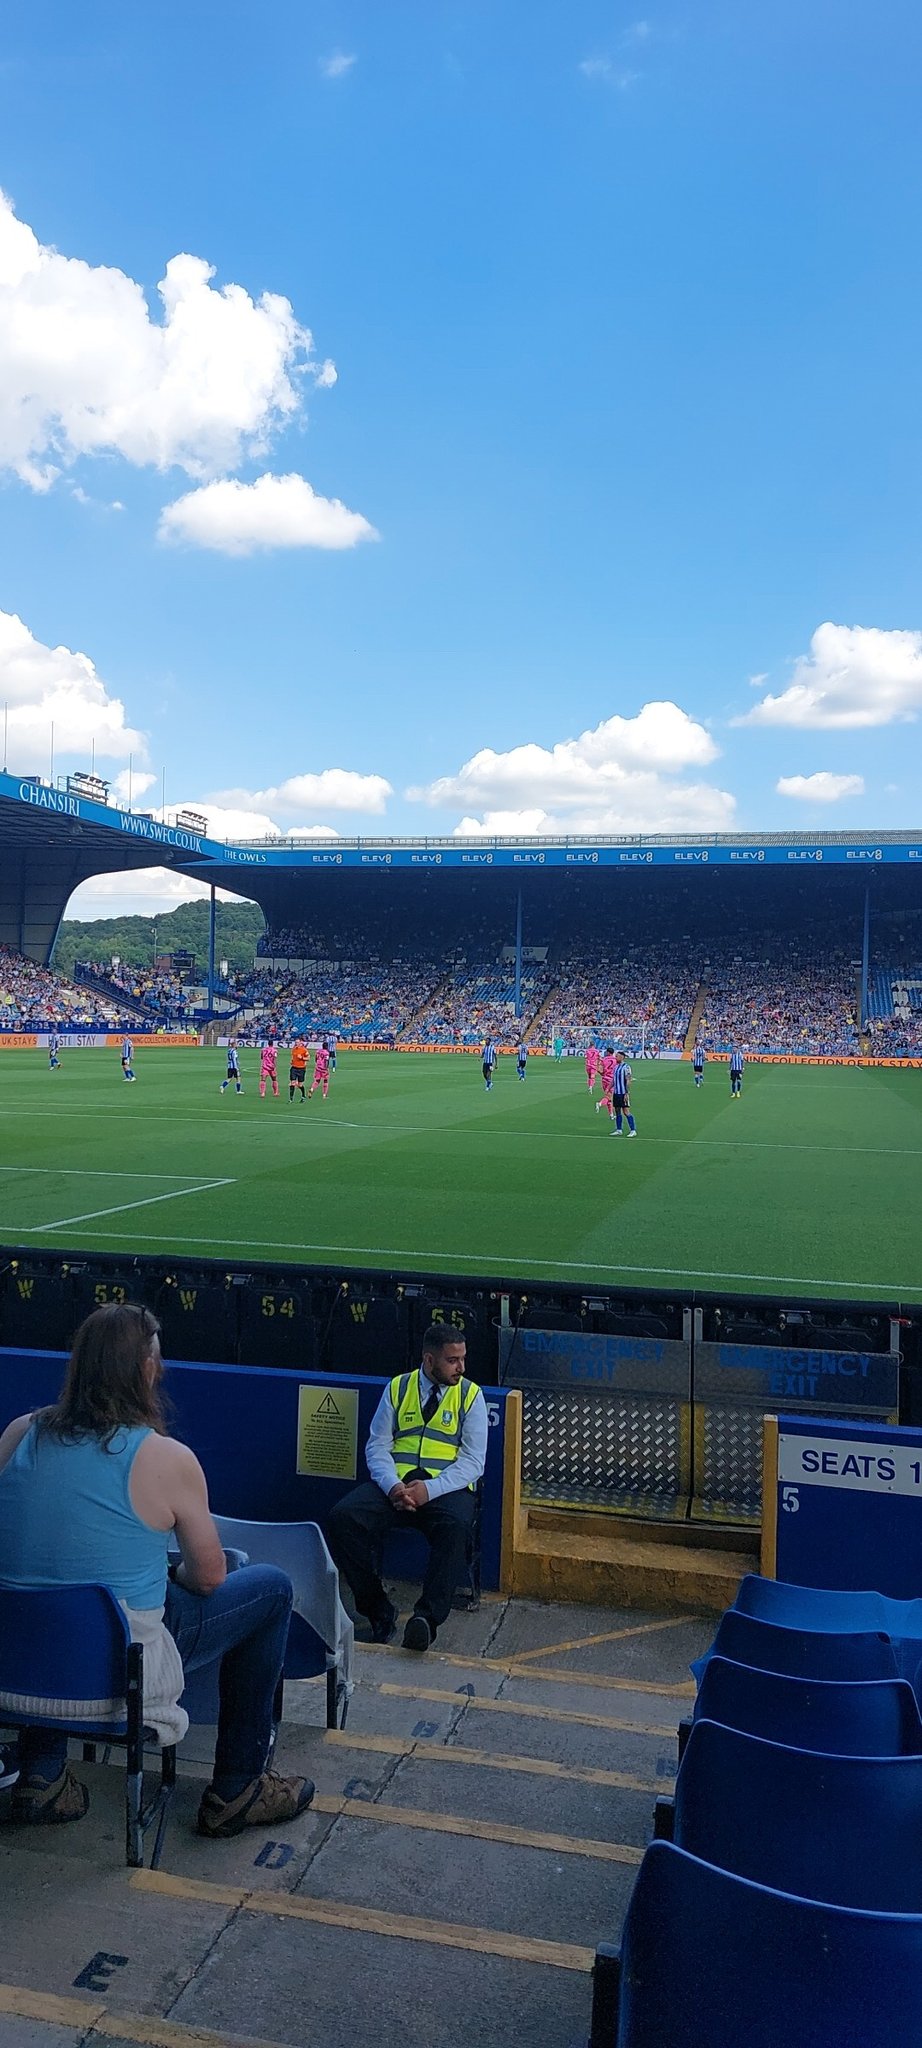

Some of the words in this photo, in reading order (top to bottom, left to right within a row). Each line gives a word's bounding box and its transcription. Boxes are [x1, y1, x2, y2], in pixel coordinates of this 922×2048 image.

[19, 783, 80, 817] CHANSIRI
[119, 813, 202, 853] WWW.SWFC.CO.UK
[224, 849, 236, 860] THE
[238, 852, 267, 863] OWLS
[312, 853, 342, 864] ELEV8
[361, 853, 392, 864] ELEV8
[411, 853, 442, 864] ELEV8
[462, 853, 493, 864] ELEV8
[513, 852, 545, 863] ELEV8
[566, 852, 599, 863] ELEV8
[619, 851, 653, 863] ELEV8
[674, 851, 709, 862] ELEV8
[730, 850, 765, 861] ELEV8
[787, 849, 823, 861] ELEV8
[846, 849, 883, 860] ELEV8
[1, 1036, 12, 1045] UK
[13, 1036, 37, 1045] STAYS
[76, 1035, 97, 1046] STAY
[263, 1050, 273, 1059] 26
[408, 1046, 467, 1054] COLLECTION
[590, 1050, 596, 1058] 7
[771, 1056, 843, 1066] COLLECTION
[847, 1059, 863, 1067] OF
[16, 1279, 34, 1299] W
[179, 1290, 197, 1311] W
[261, 1296, 296, 1318] 54
[350, 1302, 368, 1323] W
[431, 1308, 466, 1331] 55
[719, 1344, 871, 1377] EMERGENCY
[769, 1372, 817, 1398] EXIT
[486, 1402, 500, 1427] 5
[801, 1449, 896, 1481] SEATS
[782, 1486, 800, 1513] 5
[253, 1840, 295, 1870] D
[71, 1950, 130, 1993] E
